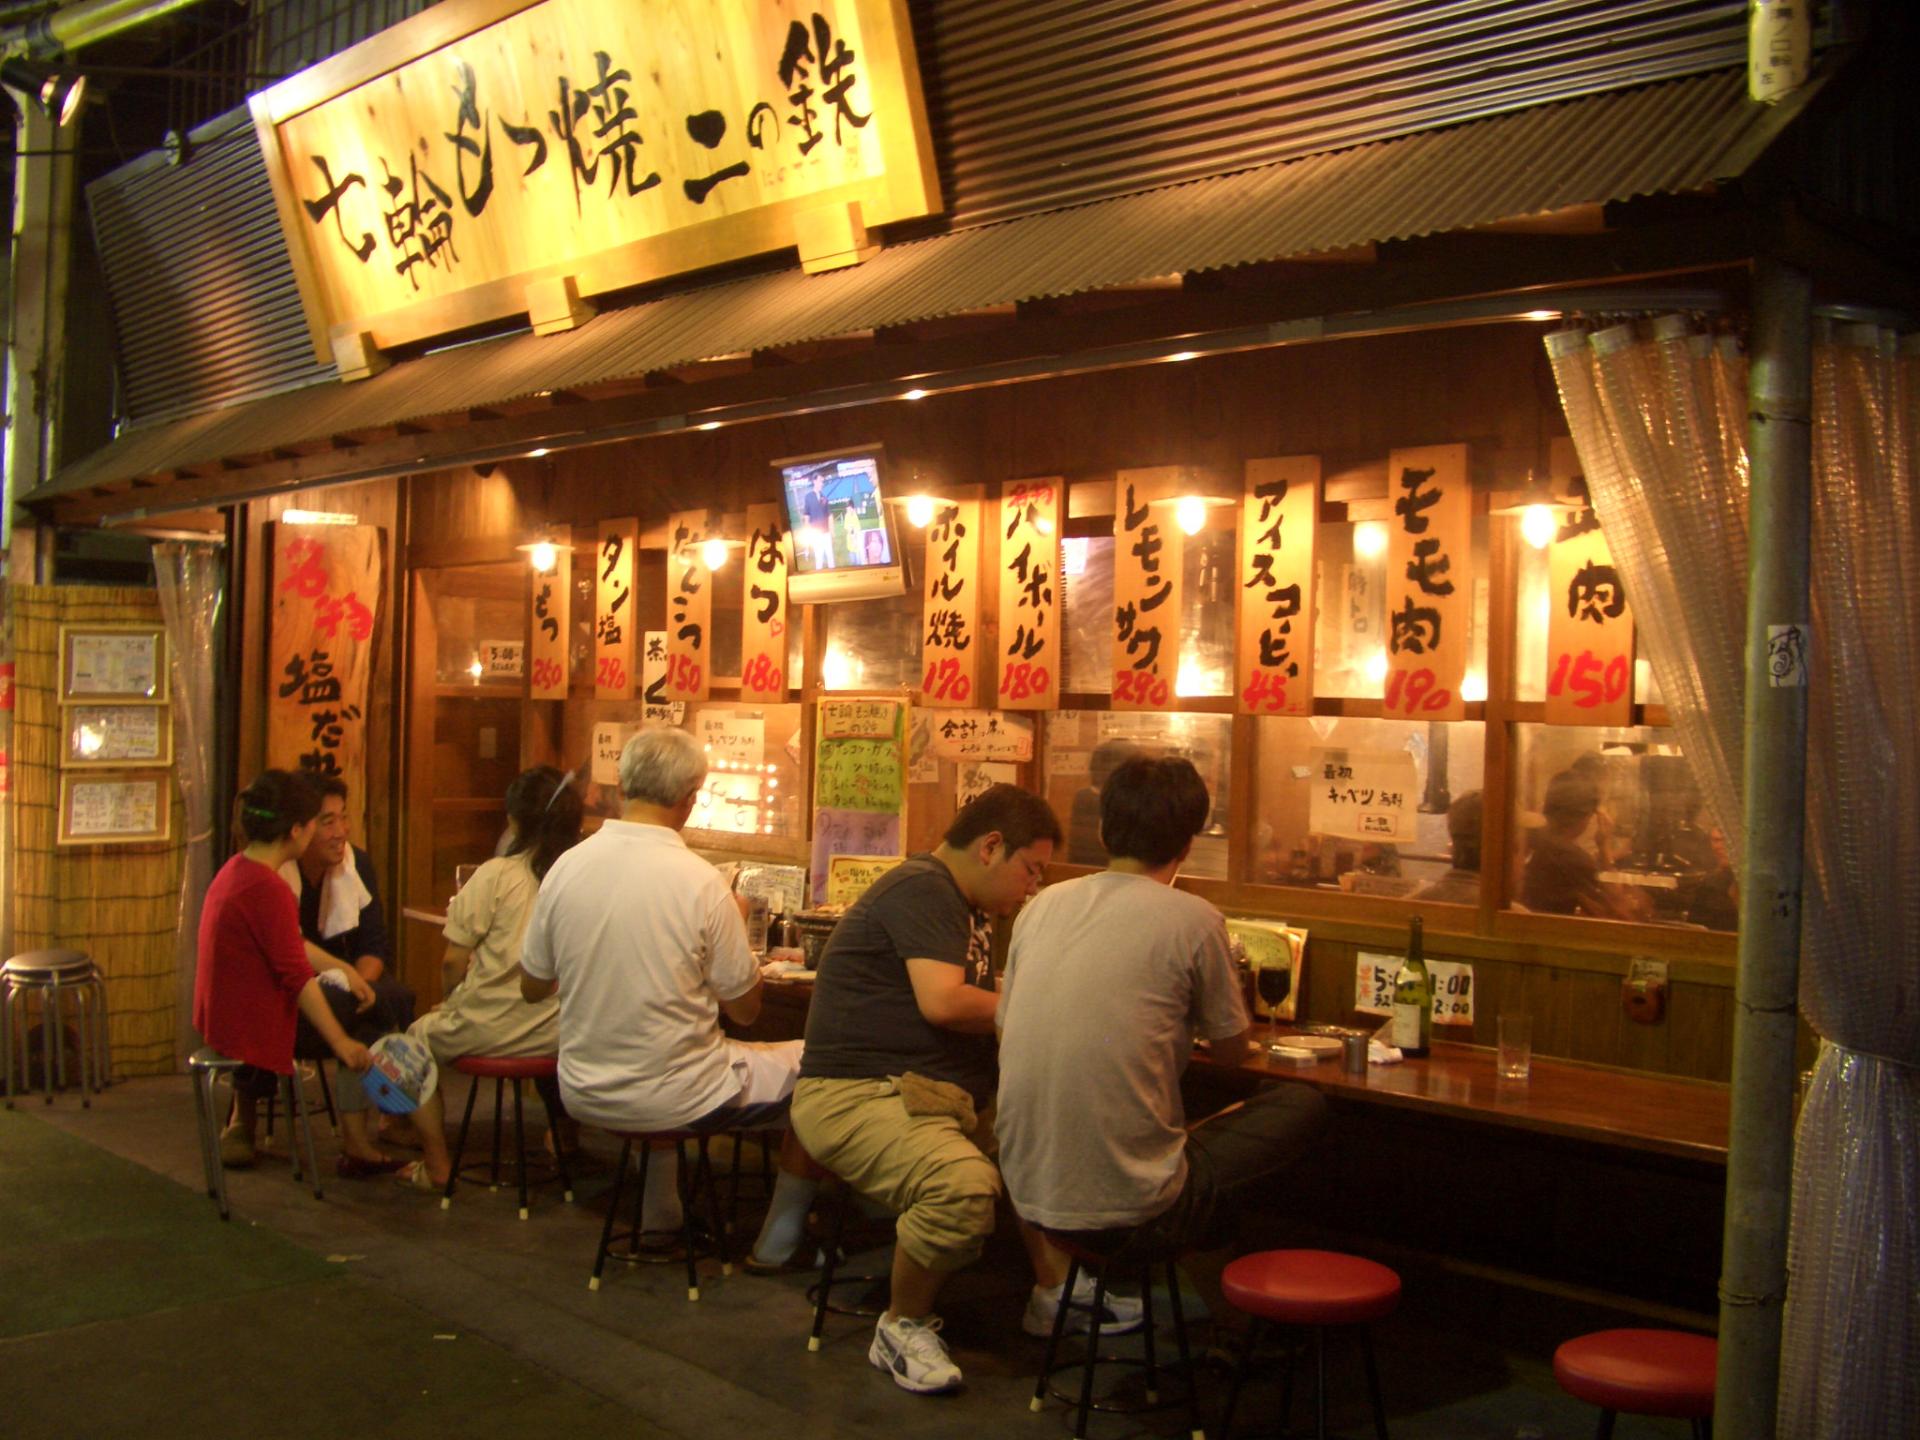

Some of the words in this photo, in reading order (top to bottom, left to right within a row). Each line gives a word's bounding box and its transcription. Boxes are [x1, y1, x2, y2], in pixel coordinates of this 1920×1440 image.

[748, 523, 785, 624] はつ
[925, 505, 971, 651] ホイル焼
[1115, 484, 1173, 675] レモンサワー
[1244, 479, 1301, 678] アイスコーヒー
[1389, 467, 1455, 655] モモ肉
[281, 537, 374, 642] 名物
[597, 534, 630, 646] タン塩
[672, 520, 702, 650] なんこつ
[532, 657, 563, 690] 250
[595, 657, 626, 690] 290
[667, 653, 701, 695] 150
[742, 651, 782, 693] 180
[923, 657, 971, 700] 170
[999, 662, 1051, 701] 180
[1112, 670, 1169, 707] 290
[1384, 668, 1453, 715] 190
[1549, 651, 1629, 708] 150
[1323, 763, 1354, 780] 最初
[1327, 786, 1375, 806] キャベツ
[1434, 999, 1469, 1015] 2:00
